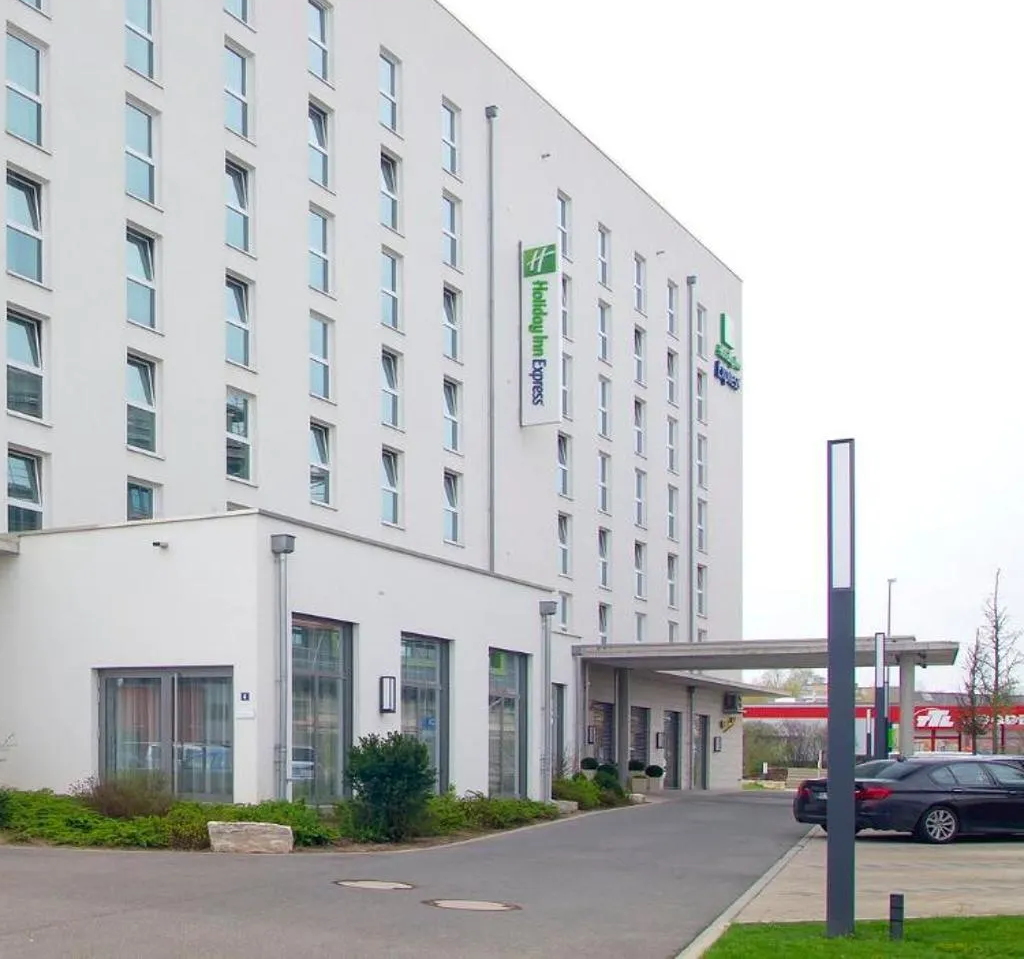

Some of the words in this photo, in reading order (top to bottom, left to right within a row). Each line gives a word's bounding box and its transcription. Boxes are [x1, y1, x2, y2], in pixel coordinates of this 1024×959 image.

[529, 280, 549, 334] Holiday
[532, 335, 549, 357] Inn
[528, 359, 547, 406] Express
